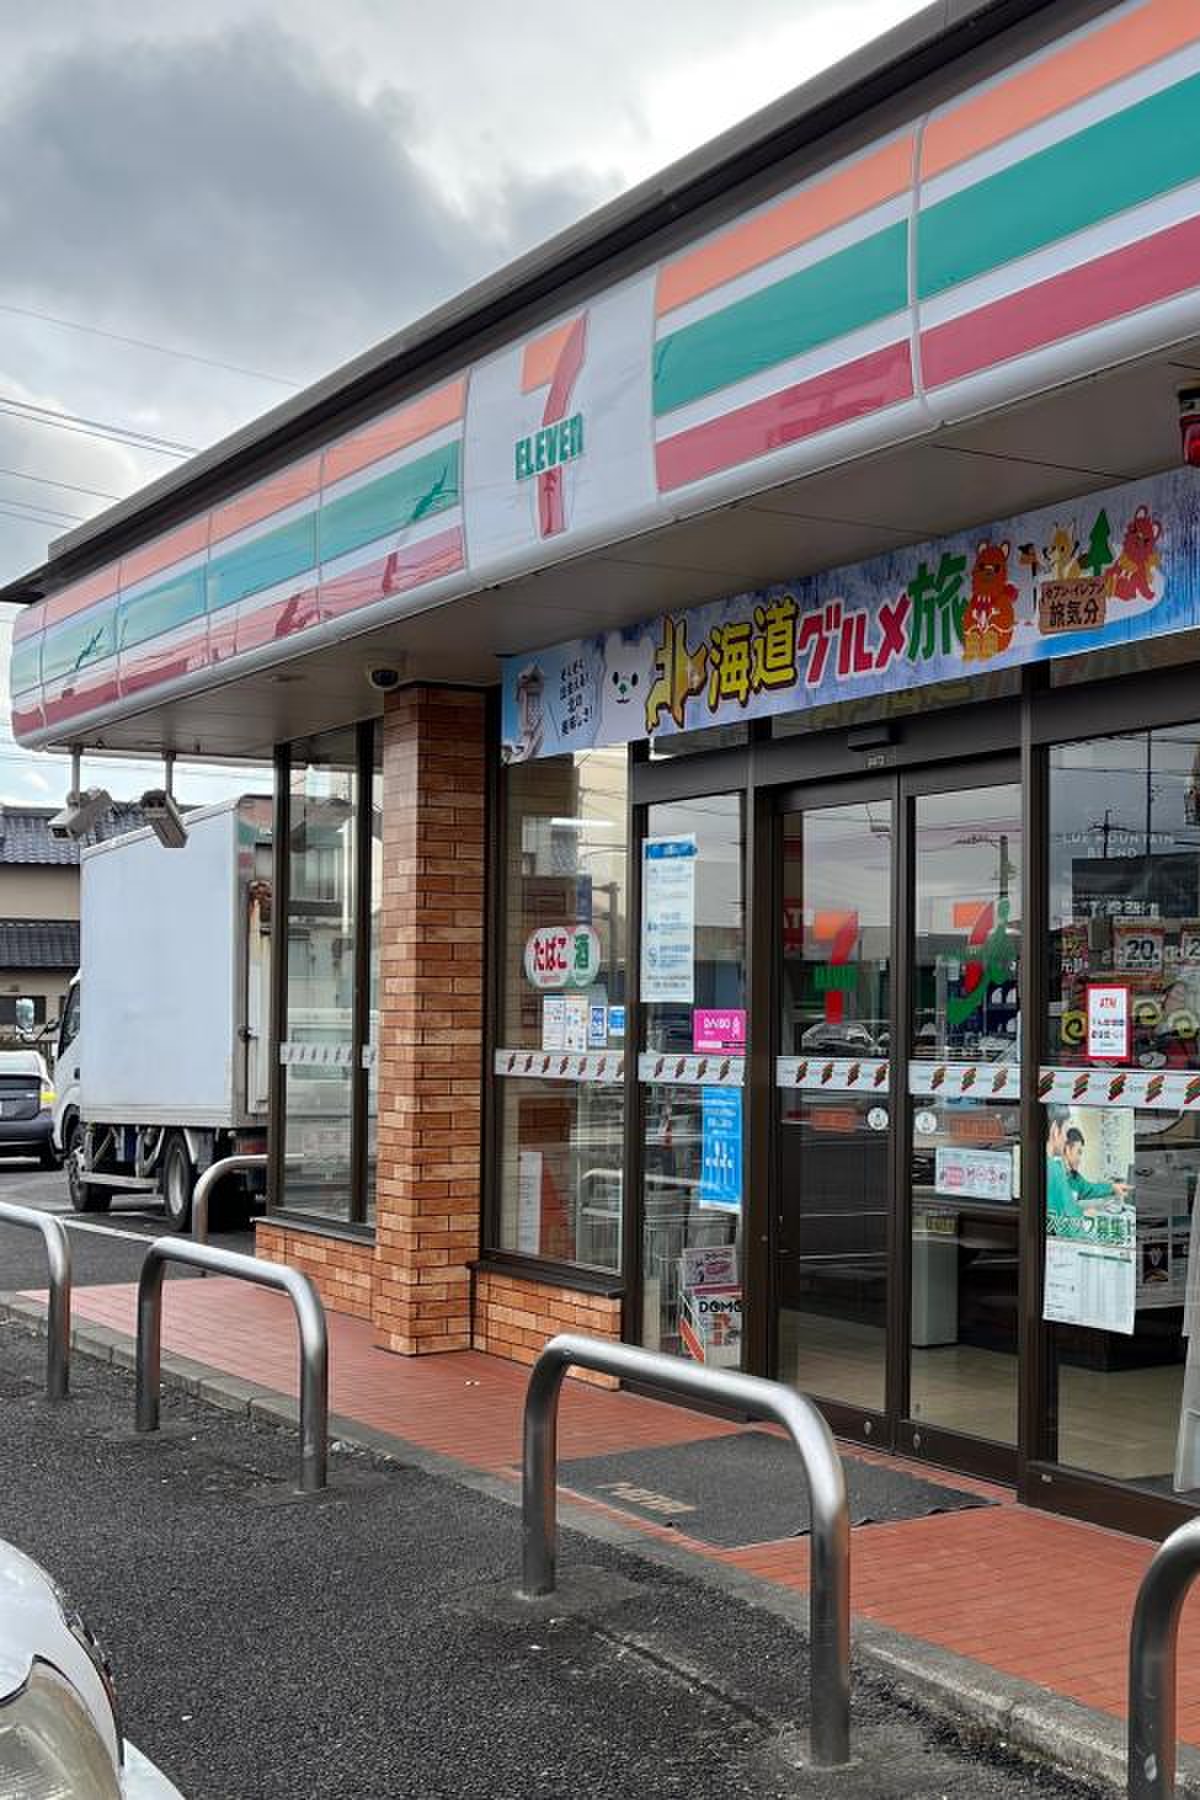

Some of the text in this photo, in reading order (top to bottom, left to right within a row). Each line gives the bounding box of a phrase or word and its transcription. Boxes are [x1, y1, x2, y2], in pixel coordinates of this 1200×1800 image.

[520, 308, 590, 539] 7
[1050, 598, 1100, 627] 旅気分
[533, 933, 589, 971] たばこ 酒
